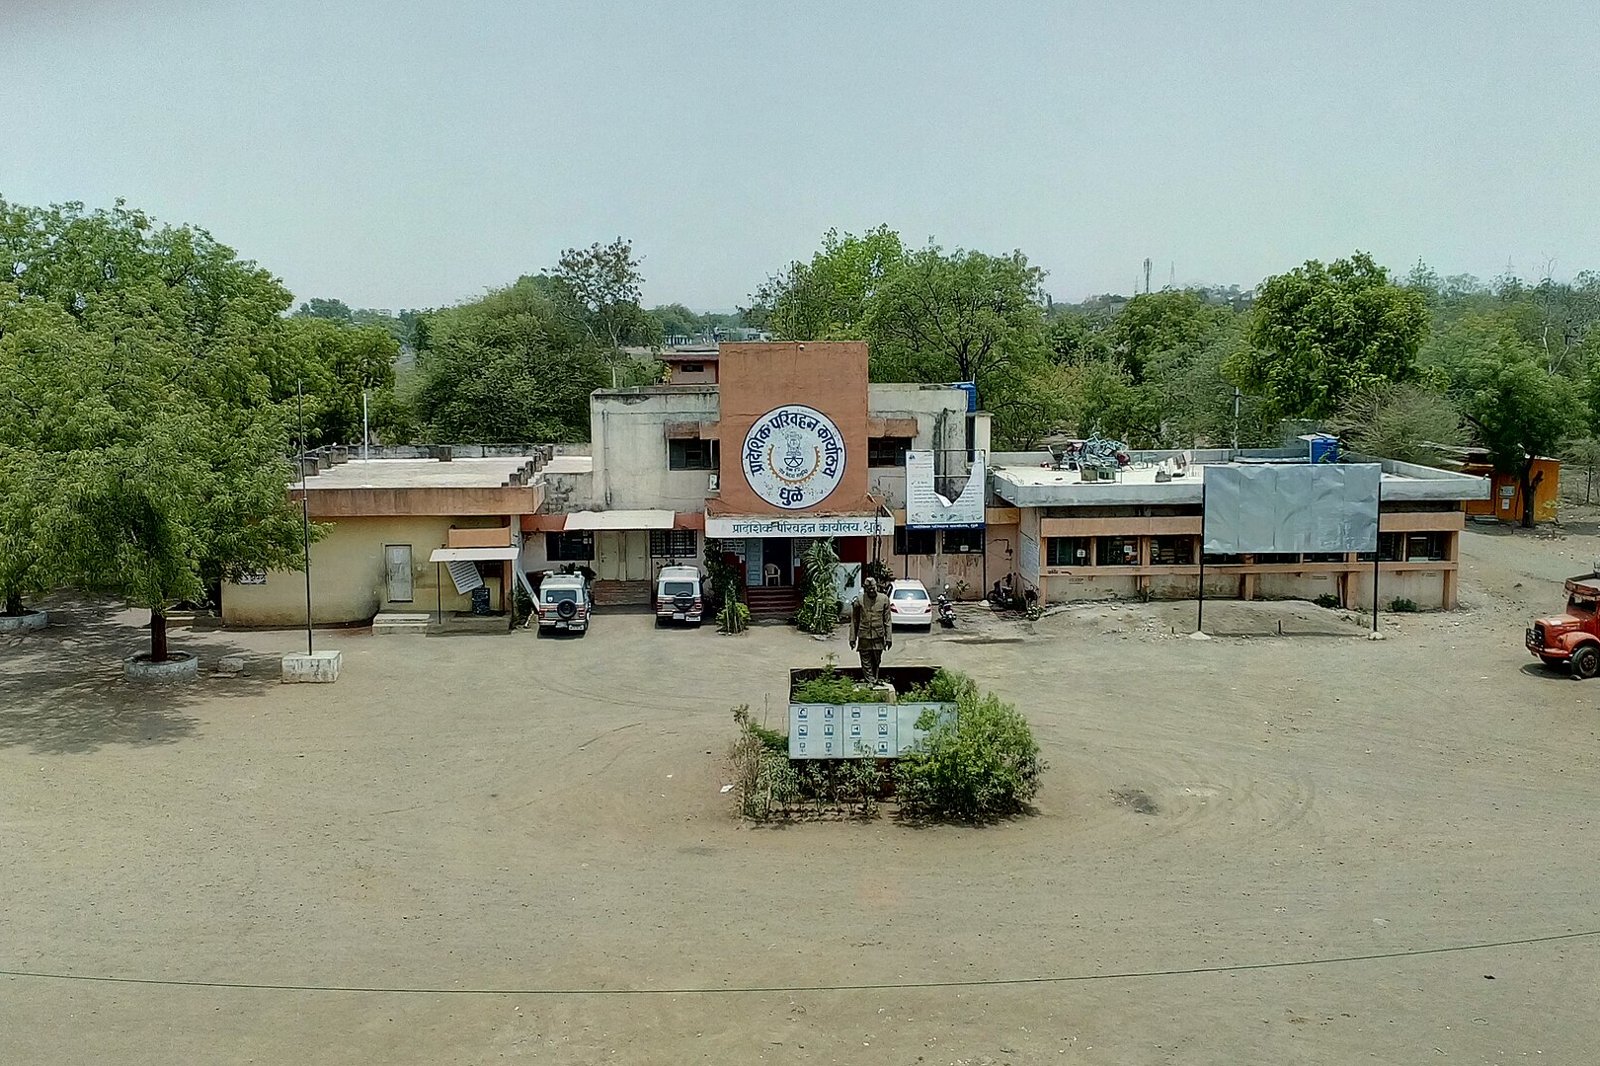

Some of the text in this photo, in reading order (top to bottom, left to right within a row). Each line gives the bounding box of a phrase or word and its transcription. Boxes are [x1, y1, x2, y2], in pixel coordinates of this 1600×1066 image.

[769, 410, 820, 432] परिवहन
[818, 424, 843, 479] कार्यालय
[779, 487, 803, 506] धुळे
[778, 520, 816, 534] परिवहन
